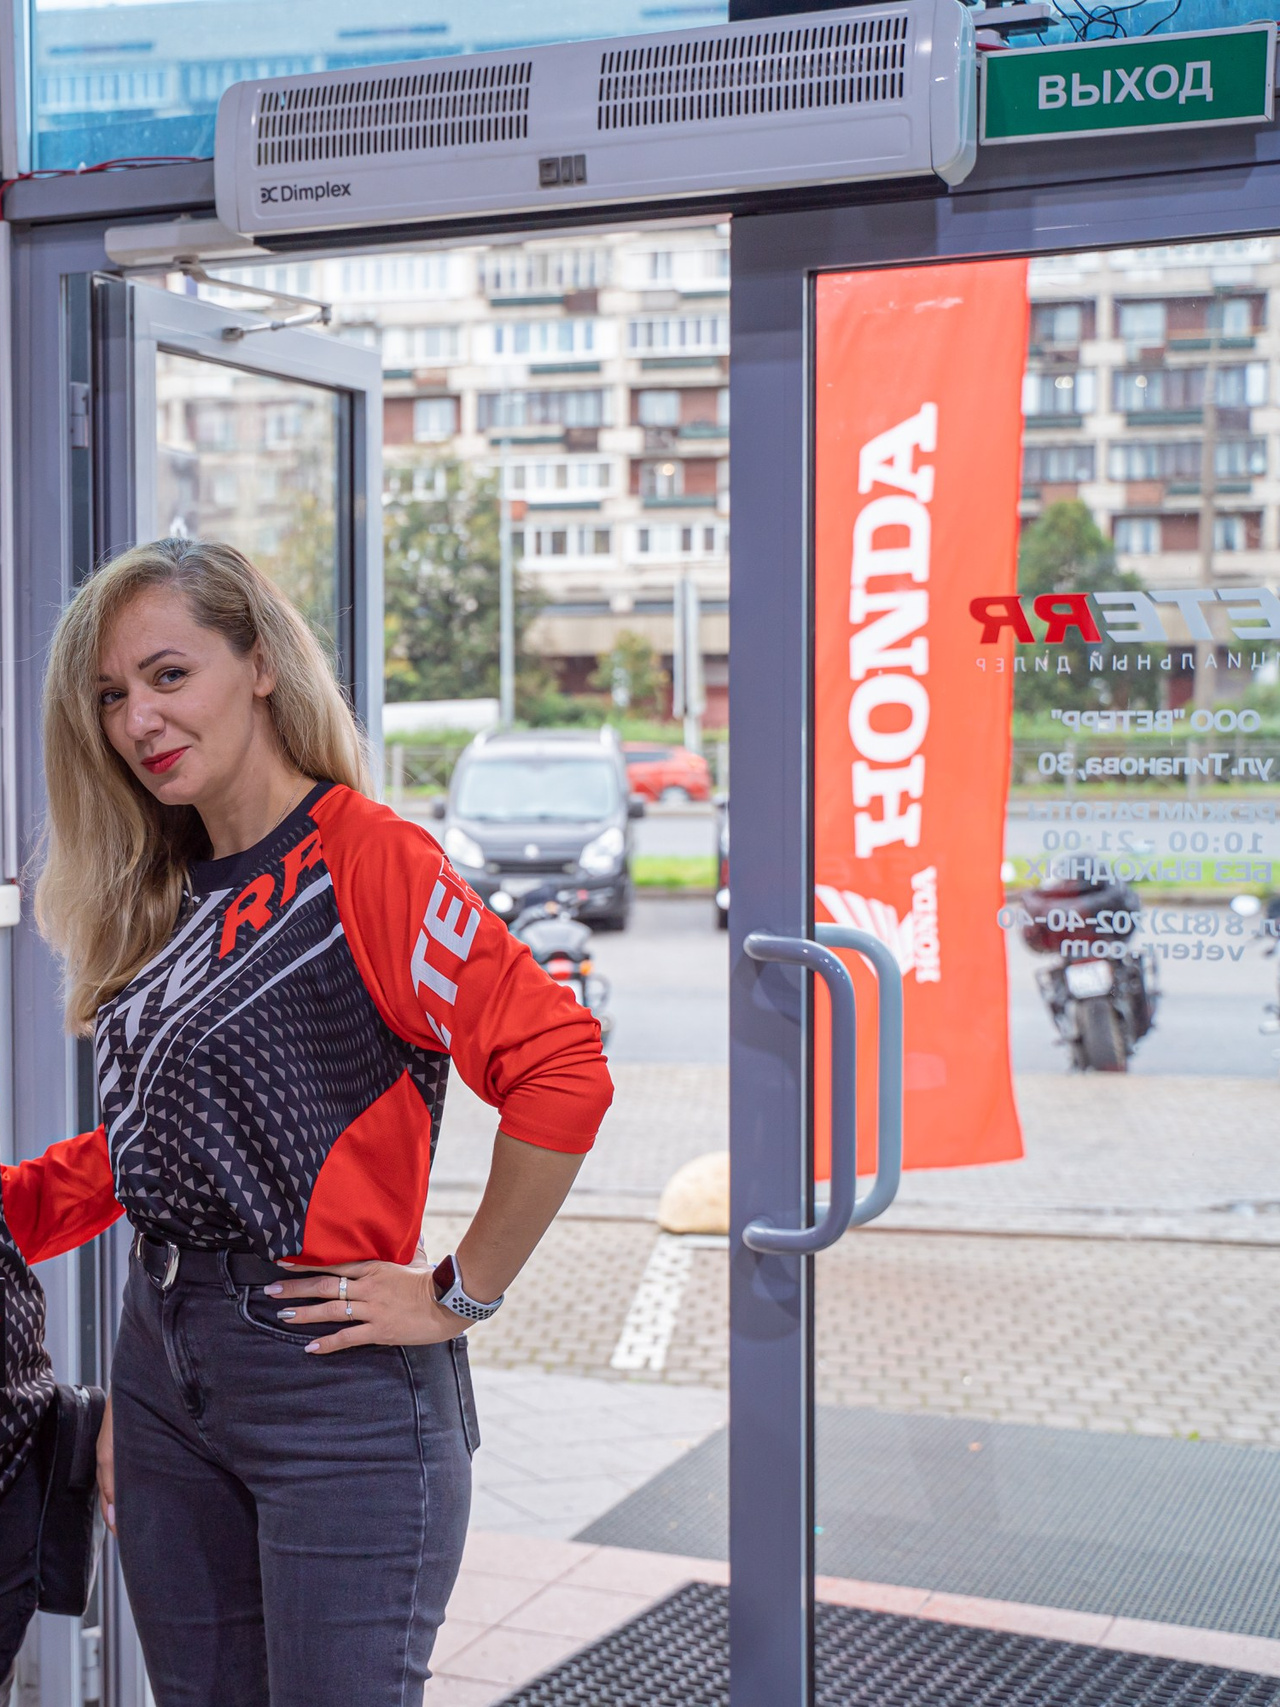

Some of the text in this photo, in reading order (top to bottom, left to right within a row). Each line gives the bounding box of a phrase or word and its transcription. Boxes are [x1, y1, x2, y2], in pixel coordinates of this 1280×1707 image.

[1039, 61, 1213, 110] ВЫХОД
[281, 181, 351, 202] Dimplex
[848, 403, 938, 859] HONDA
[911, 866, 941, 983] HONDA
